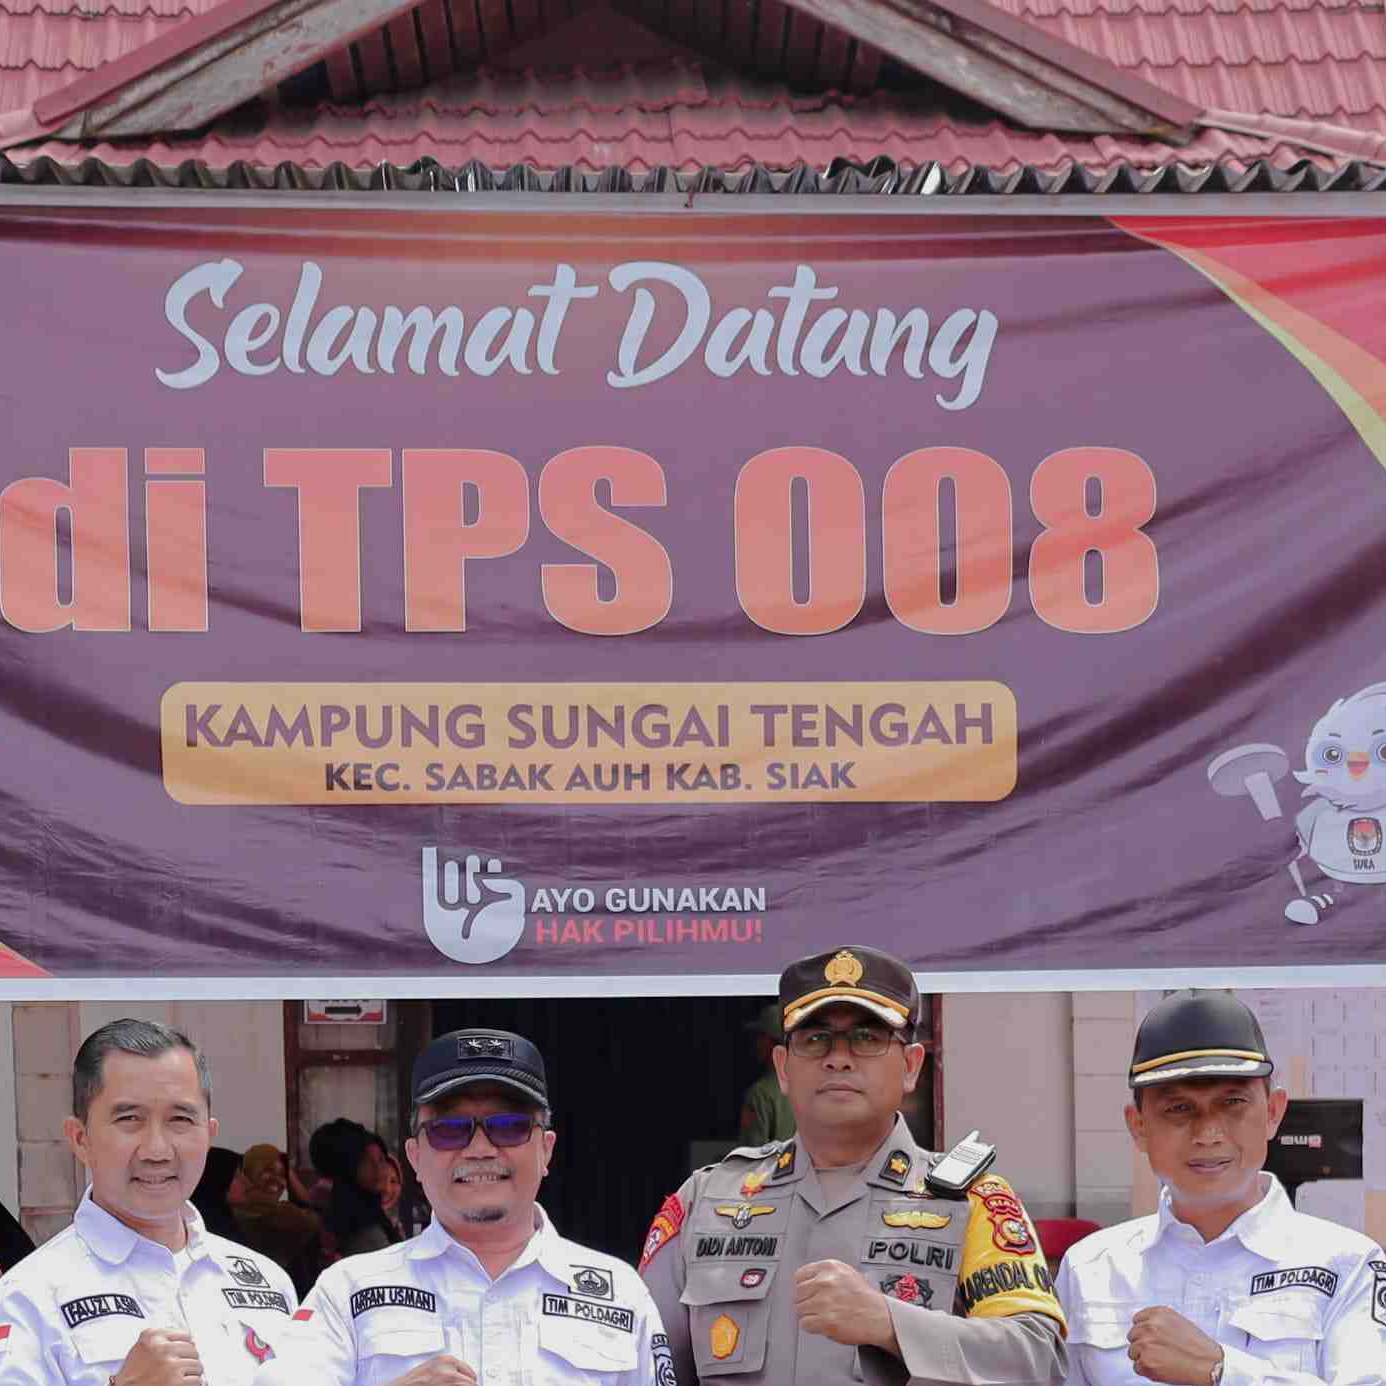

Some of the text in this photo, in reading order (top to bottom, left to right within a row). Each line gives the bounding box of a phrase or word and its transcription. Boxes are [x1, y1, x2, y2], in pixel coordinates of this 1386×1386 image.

[154, 258, 1000, 411] Selamat Datang
[262, 444, 674, 637] TPS
[733, 444, 1161, 637] 008
[184, 701, 995, 751] KAMPUNG SUNGAI TENGAH
[324, 759, 858, 793] KEC. SABAK AUH KAB. SIAK
[530, 886, 766, 915] AYO GUNAKAN
[535, 917, 764, 946] HAK PILIHMU!
[867, 1240, 956, 1271] POLRI
[1255, 1275, 1276, 1291] TIM
[68, 1296, 111, 1323] FAUZI
[388, 1287, 433, 1311] USMAN
[547, 1298, 630, 1329] TIM POLDAGRI
